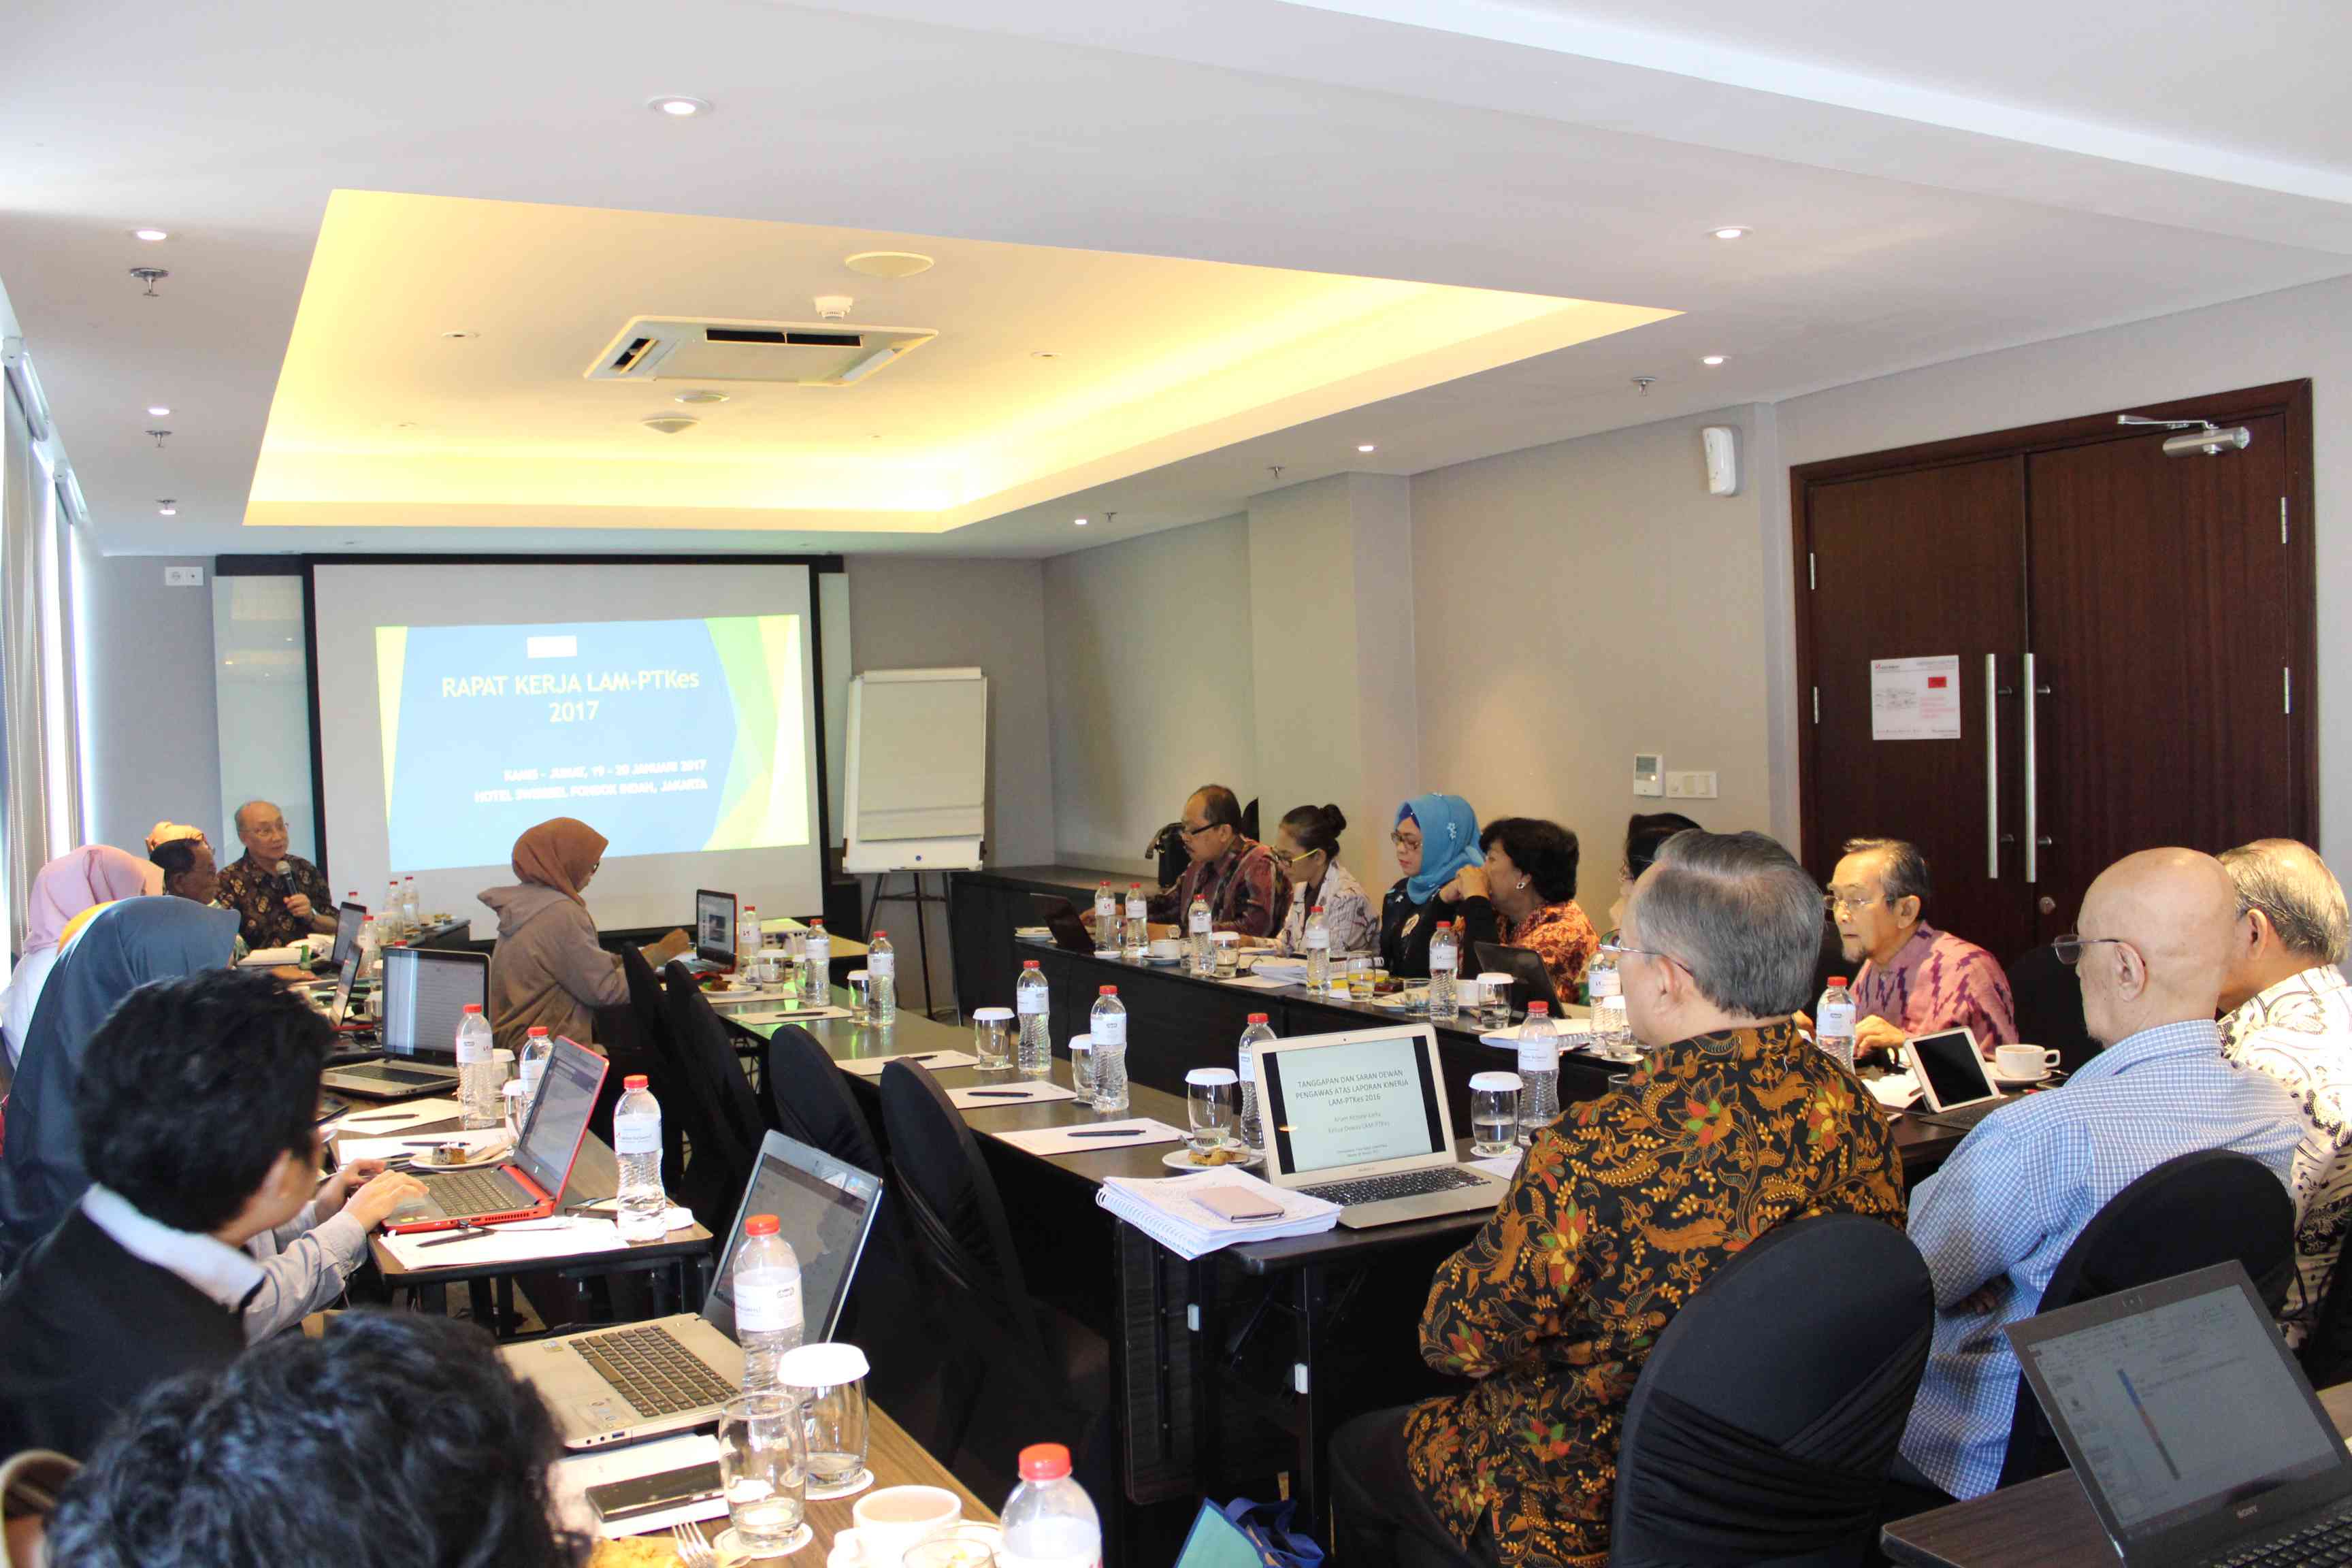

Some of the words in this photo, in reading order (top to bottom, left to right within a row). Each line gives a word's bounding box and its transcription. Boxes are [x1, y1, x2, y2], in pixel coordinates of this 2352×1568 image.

[442, 675, 508, 698] RAPAT
[514, 672, 582, 696] KERJA
[587, 669, 700, 693] LAM-PTKes
[549, 700, 599, 723] 2017
[474, 789, 512, 804] HOTEL
[1297, 1077, 1339, 1088] TANGGAPAN
[1340, 1075, 1355, 1083] DAN
[1356, 1072, 1377, 1081] SARAN
[1378, 1068, 1404, 1079] DEWAN
[1295, 1088, 1334, 1099] PENGAWAS
[1335, 1086, 1350, 1094] ATAS
[1352, 1083, 1382, 1092] LAPORAN
[1365, 1093, 1382, 1101] 2016
